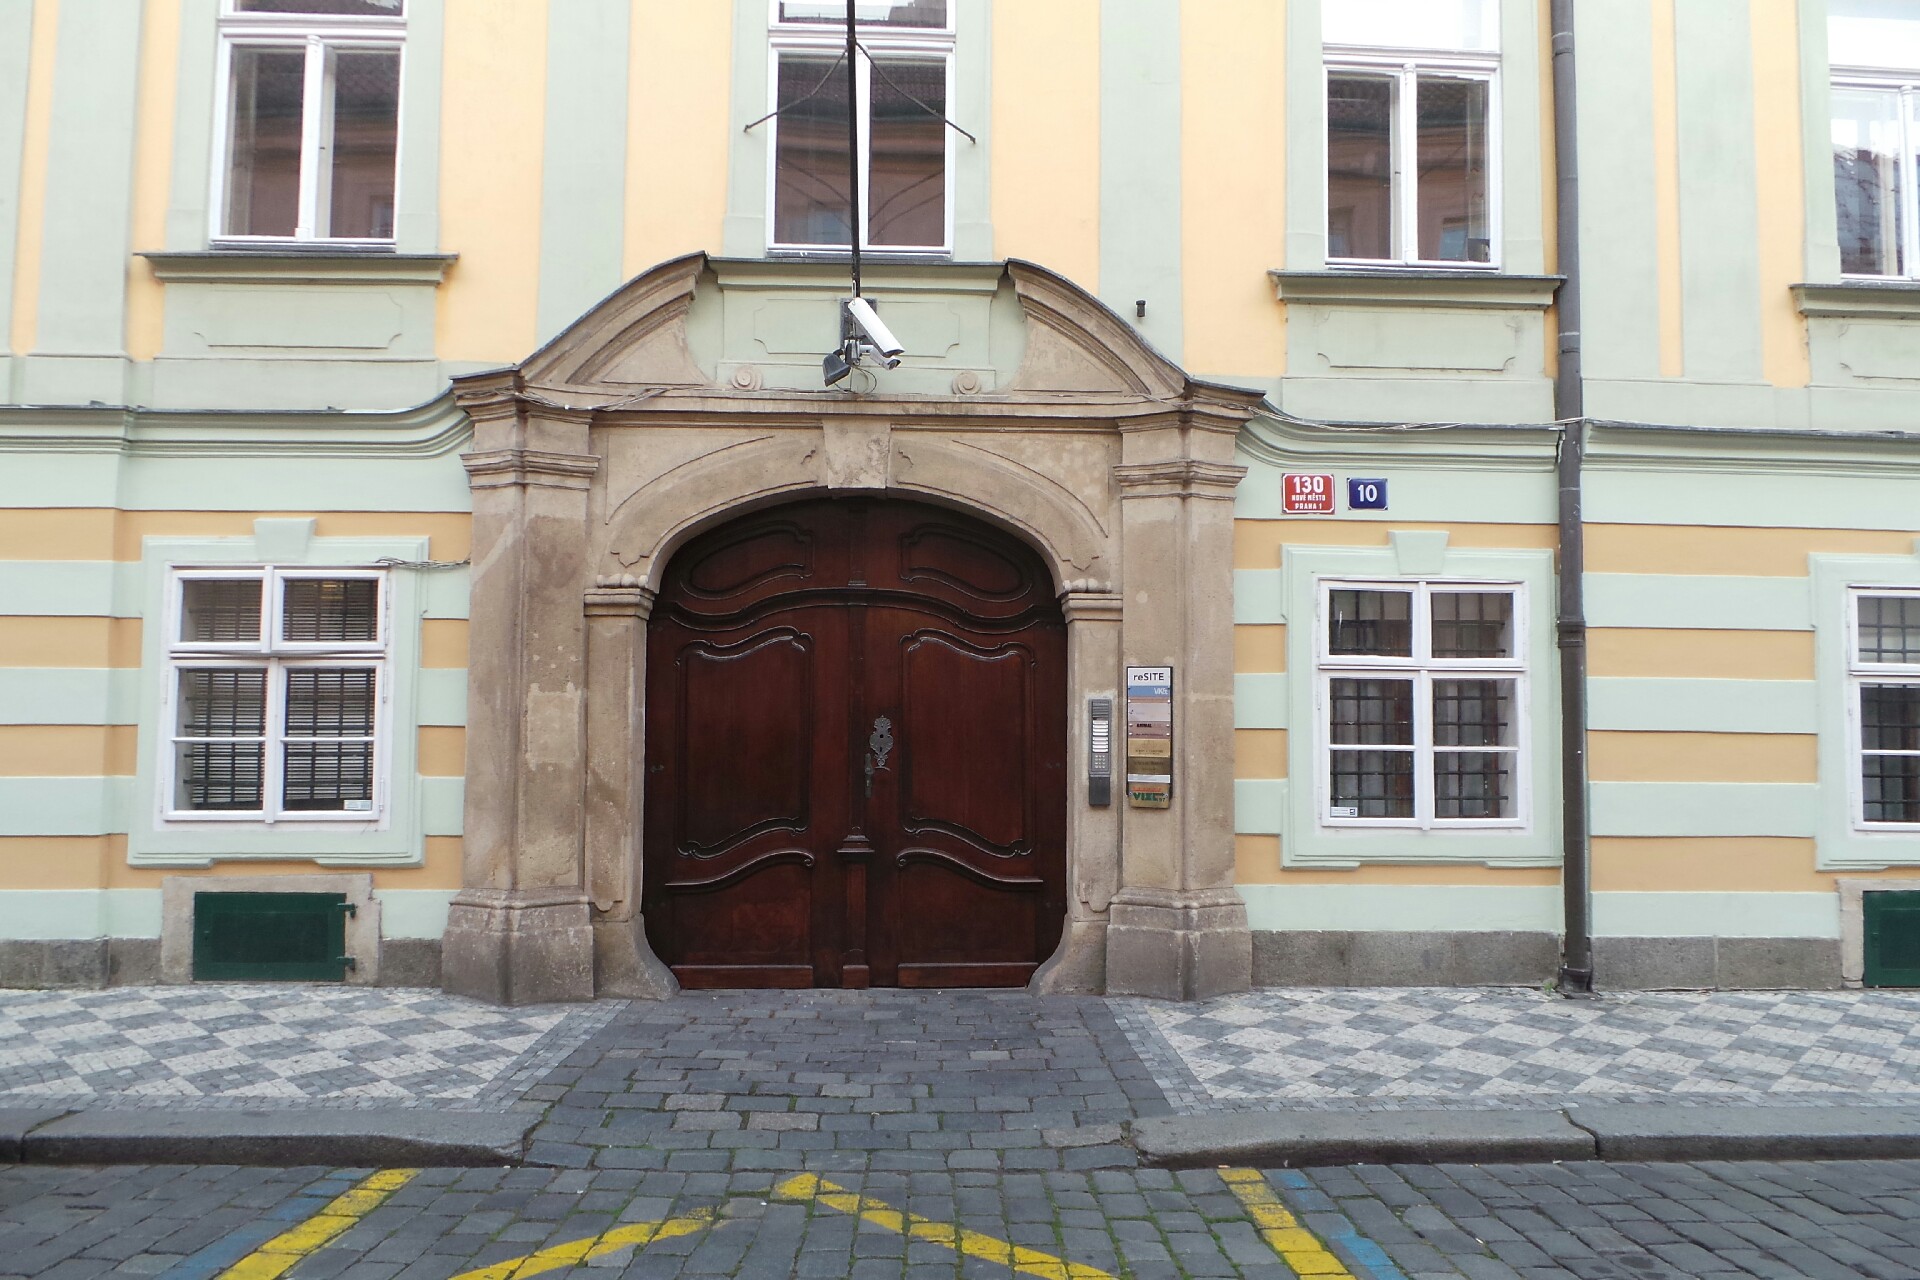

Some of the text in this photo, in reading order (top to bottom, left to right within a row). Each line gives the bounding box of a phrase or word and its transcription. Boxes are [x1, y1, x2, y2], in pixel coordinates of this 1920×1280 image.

[1293, 476, 1324, 493] 130
[1291, 493, 1326, 501] NOVÉ MĚSTO
[1358, 484, 1378, 502] 10
[1133, 672, 1164, 681] reSITE
